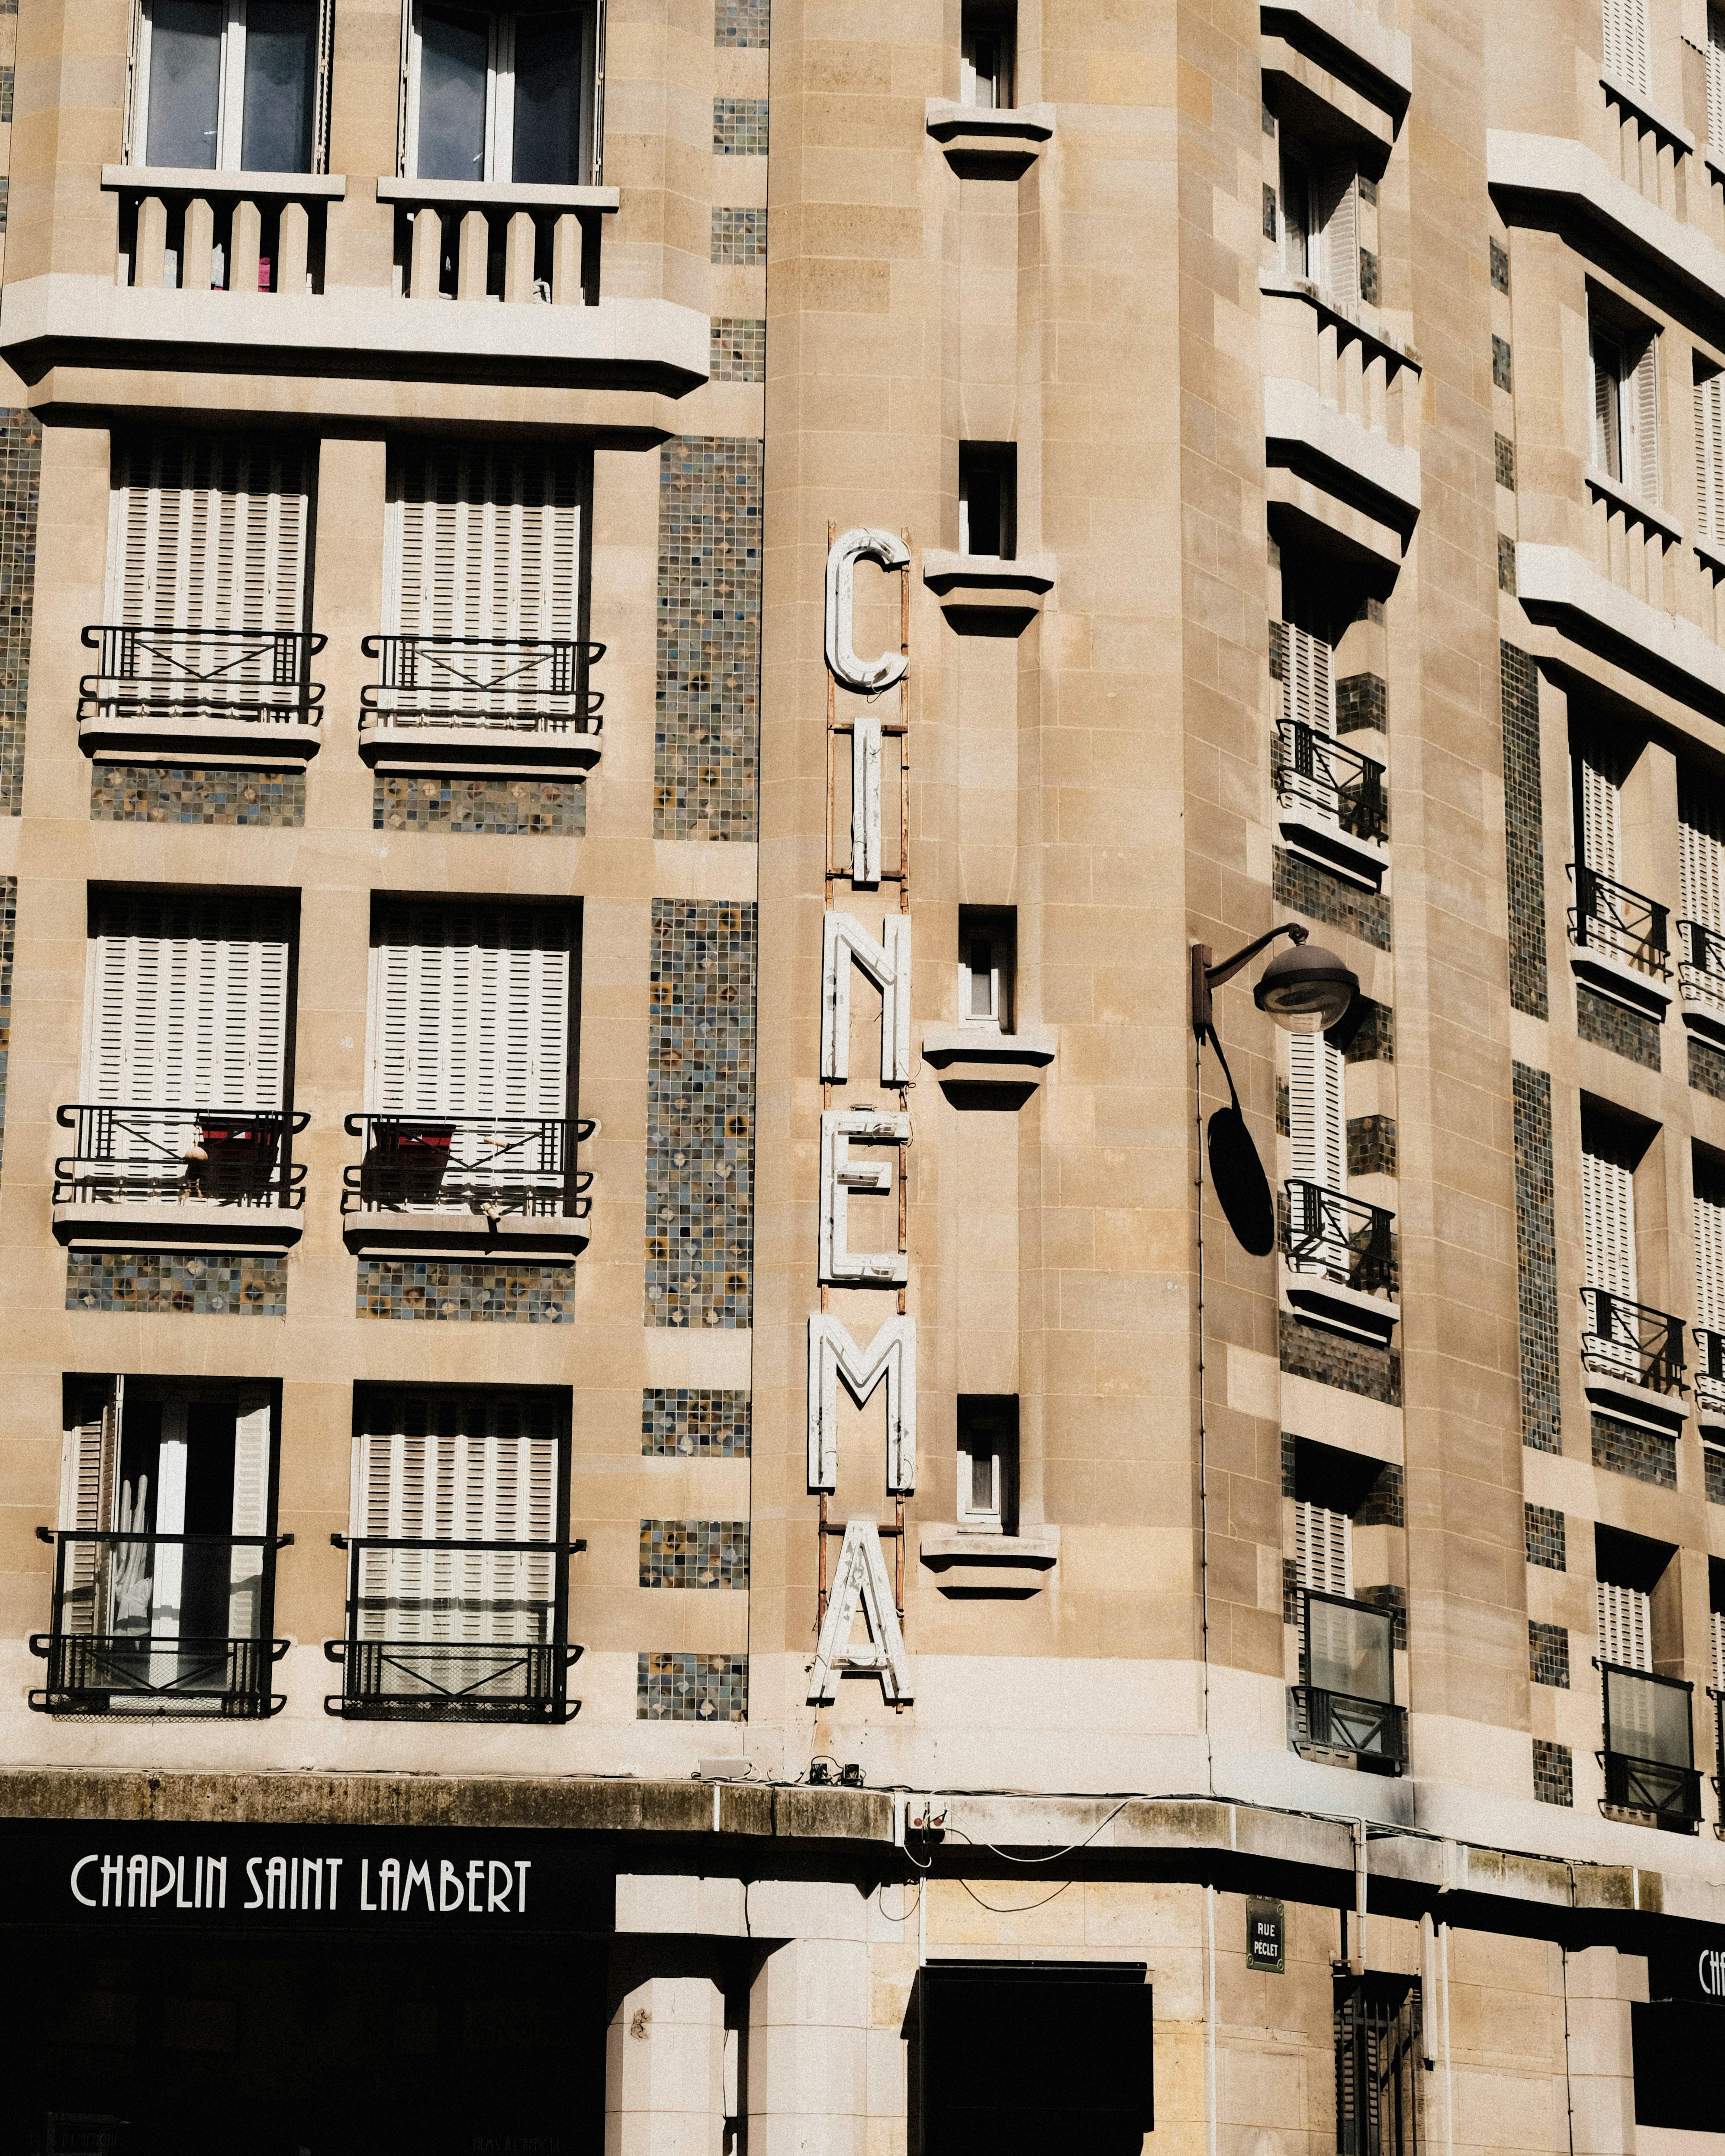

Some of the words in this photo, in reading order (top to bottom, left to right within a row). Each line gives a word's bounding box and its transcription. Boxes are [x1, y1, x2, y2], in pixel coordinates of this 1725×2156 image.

[808, 528, 917, 1706] CINEMA
[71, 1854, 227, 1908] CHAPLIN
[244, 1856, 343, 1910] SAINT
[360, 1858, 531, 1913] LAMBERT
[1254, 1940, 1278, 1957] PÉCLET
[1258, 1922, 1275, 1937] RUE
